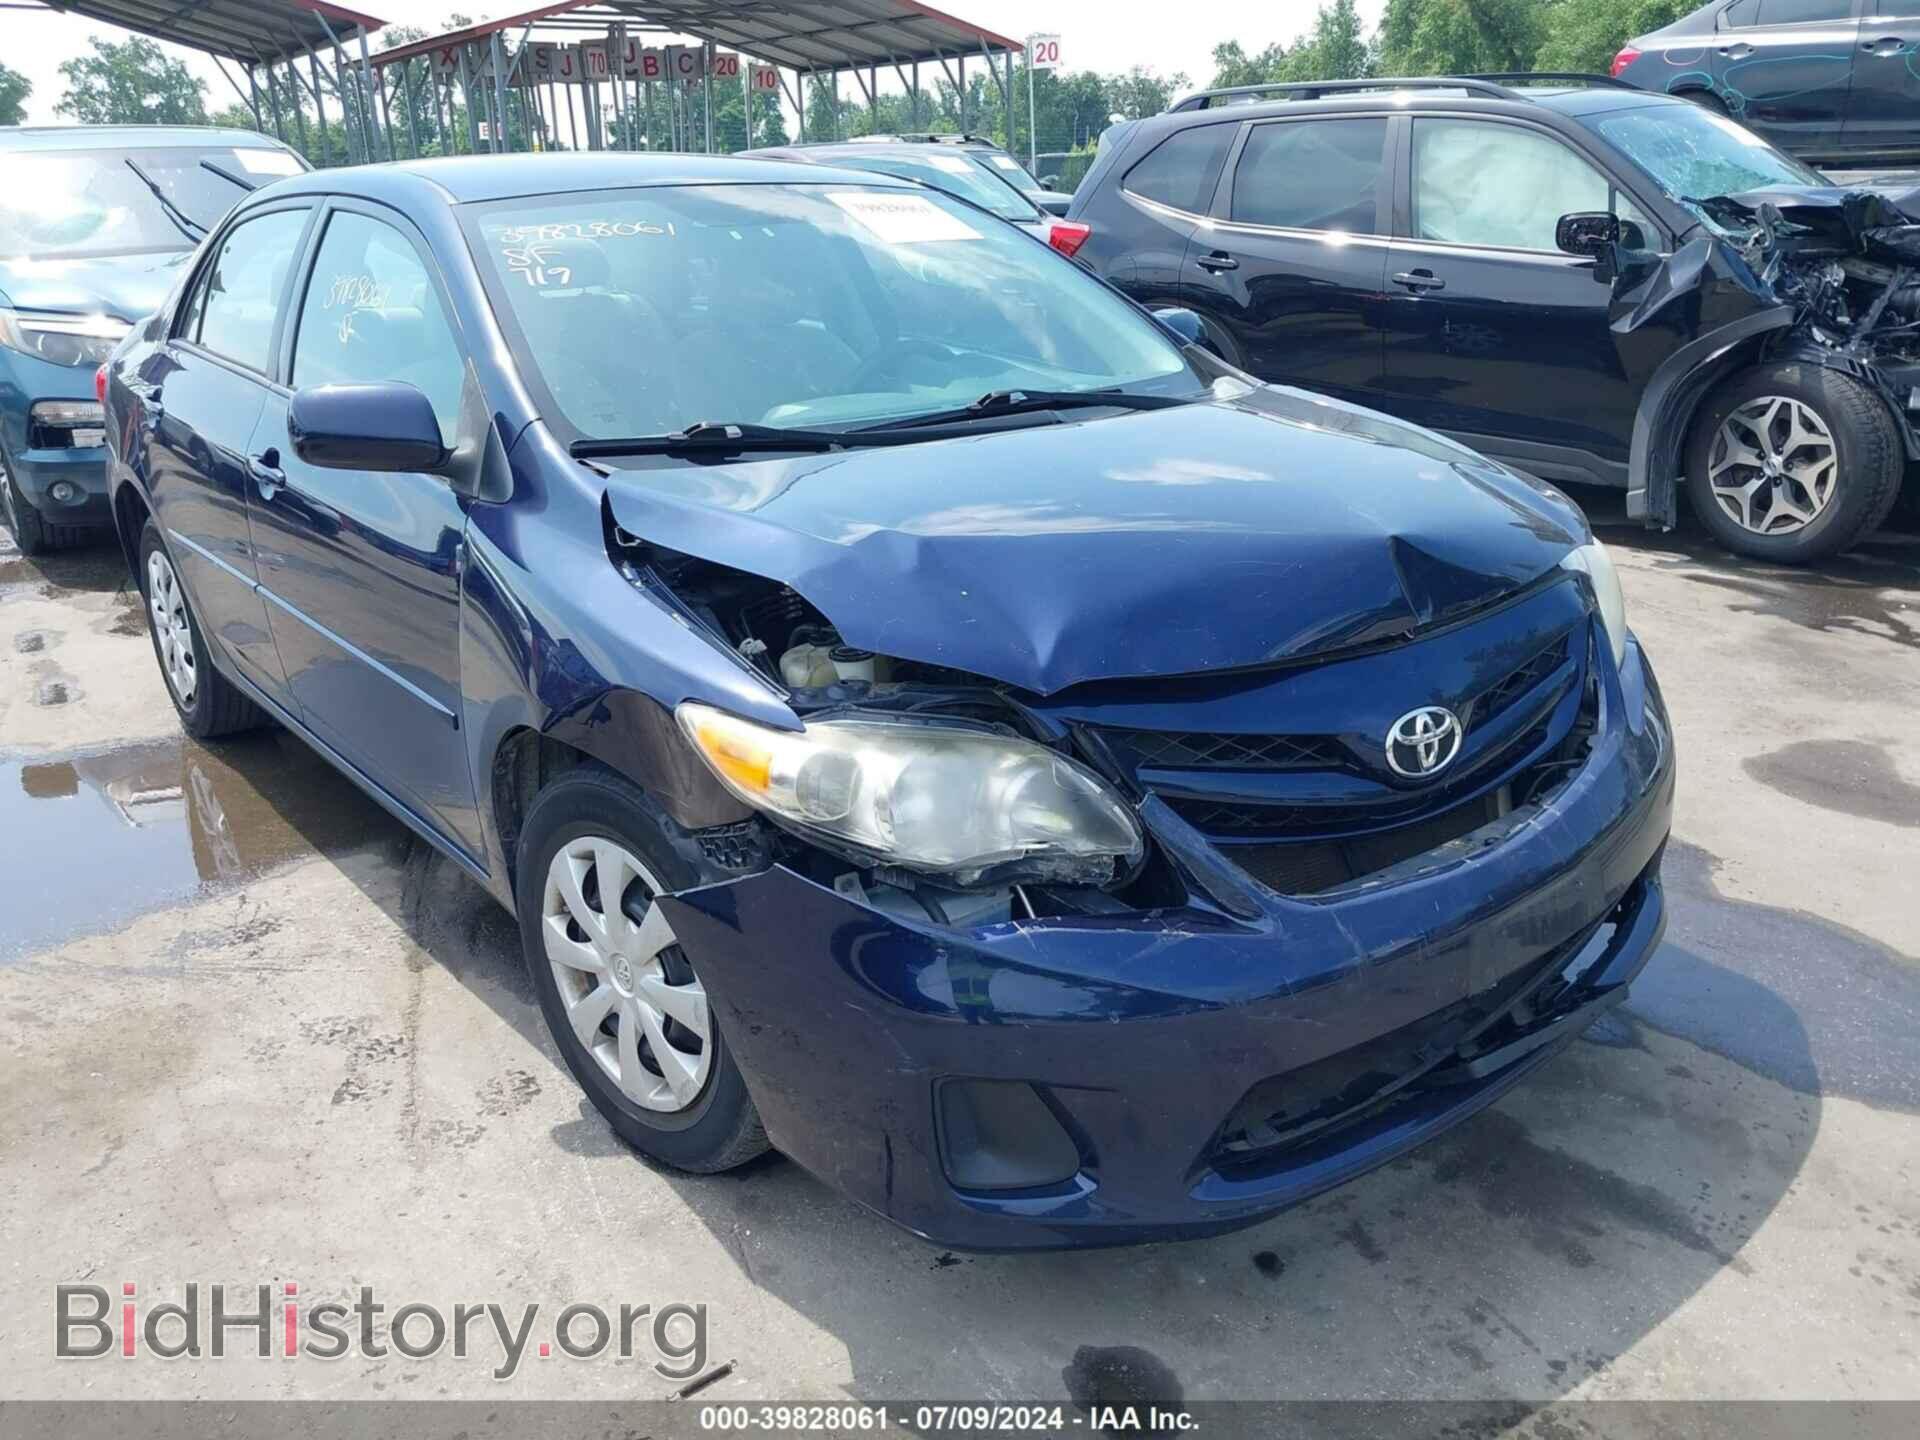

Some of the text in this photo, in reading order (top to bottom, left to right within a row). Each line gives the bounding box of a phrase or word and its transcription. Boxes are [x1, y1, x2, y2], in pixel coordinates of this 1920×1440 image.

[678, 52, 694, 73] C
[1036, 41, 1058, 63] 20
[561, 54, 573, 76] J
[643, 55, 659, 76] B
[716, 57, 738, 76] 20
[755, 70, 776, 88] 10
